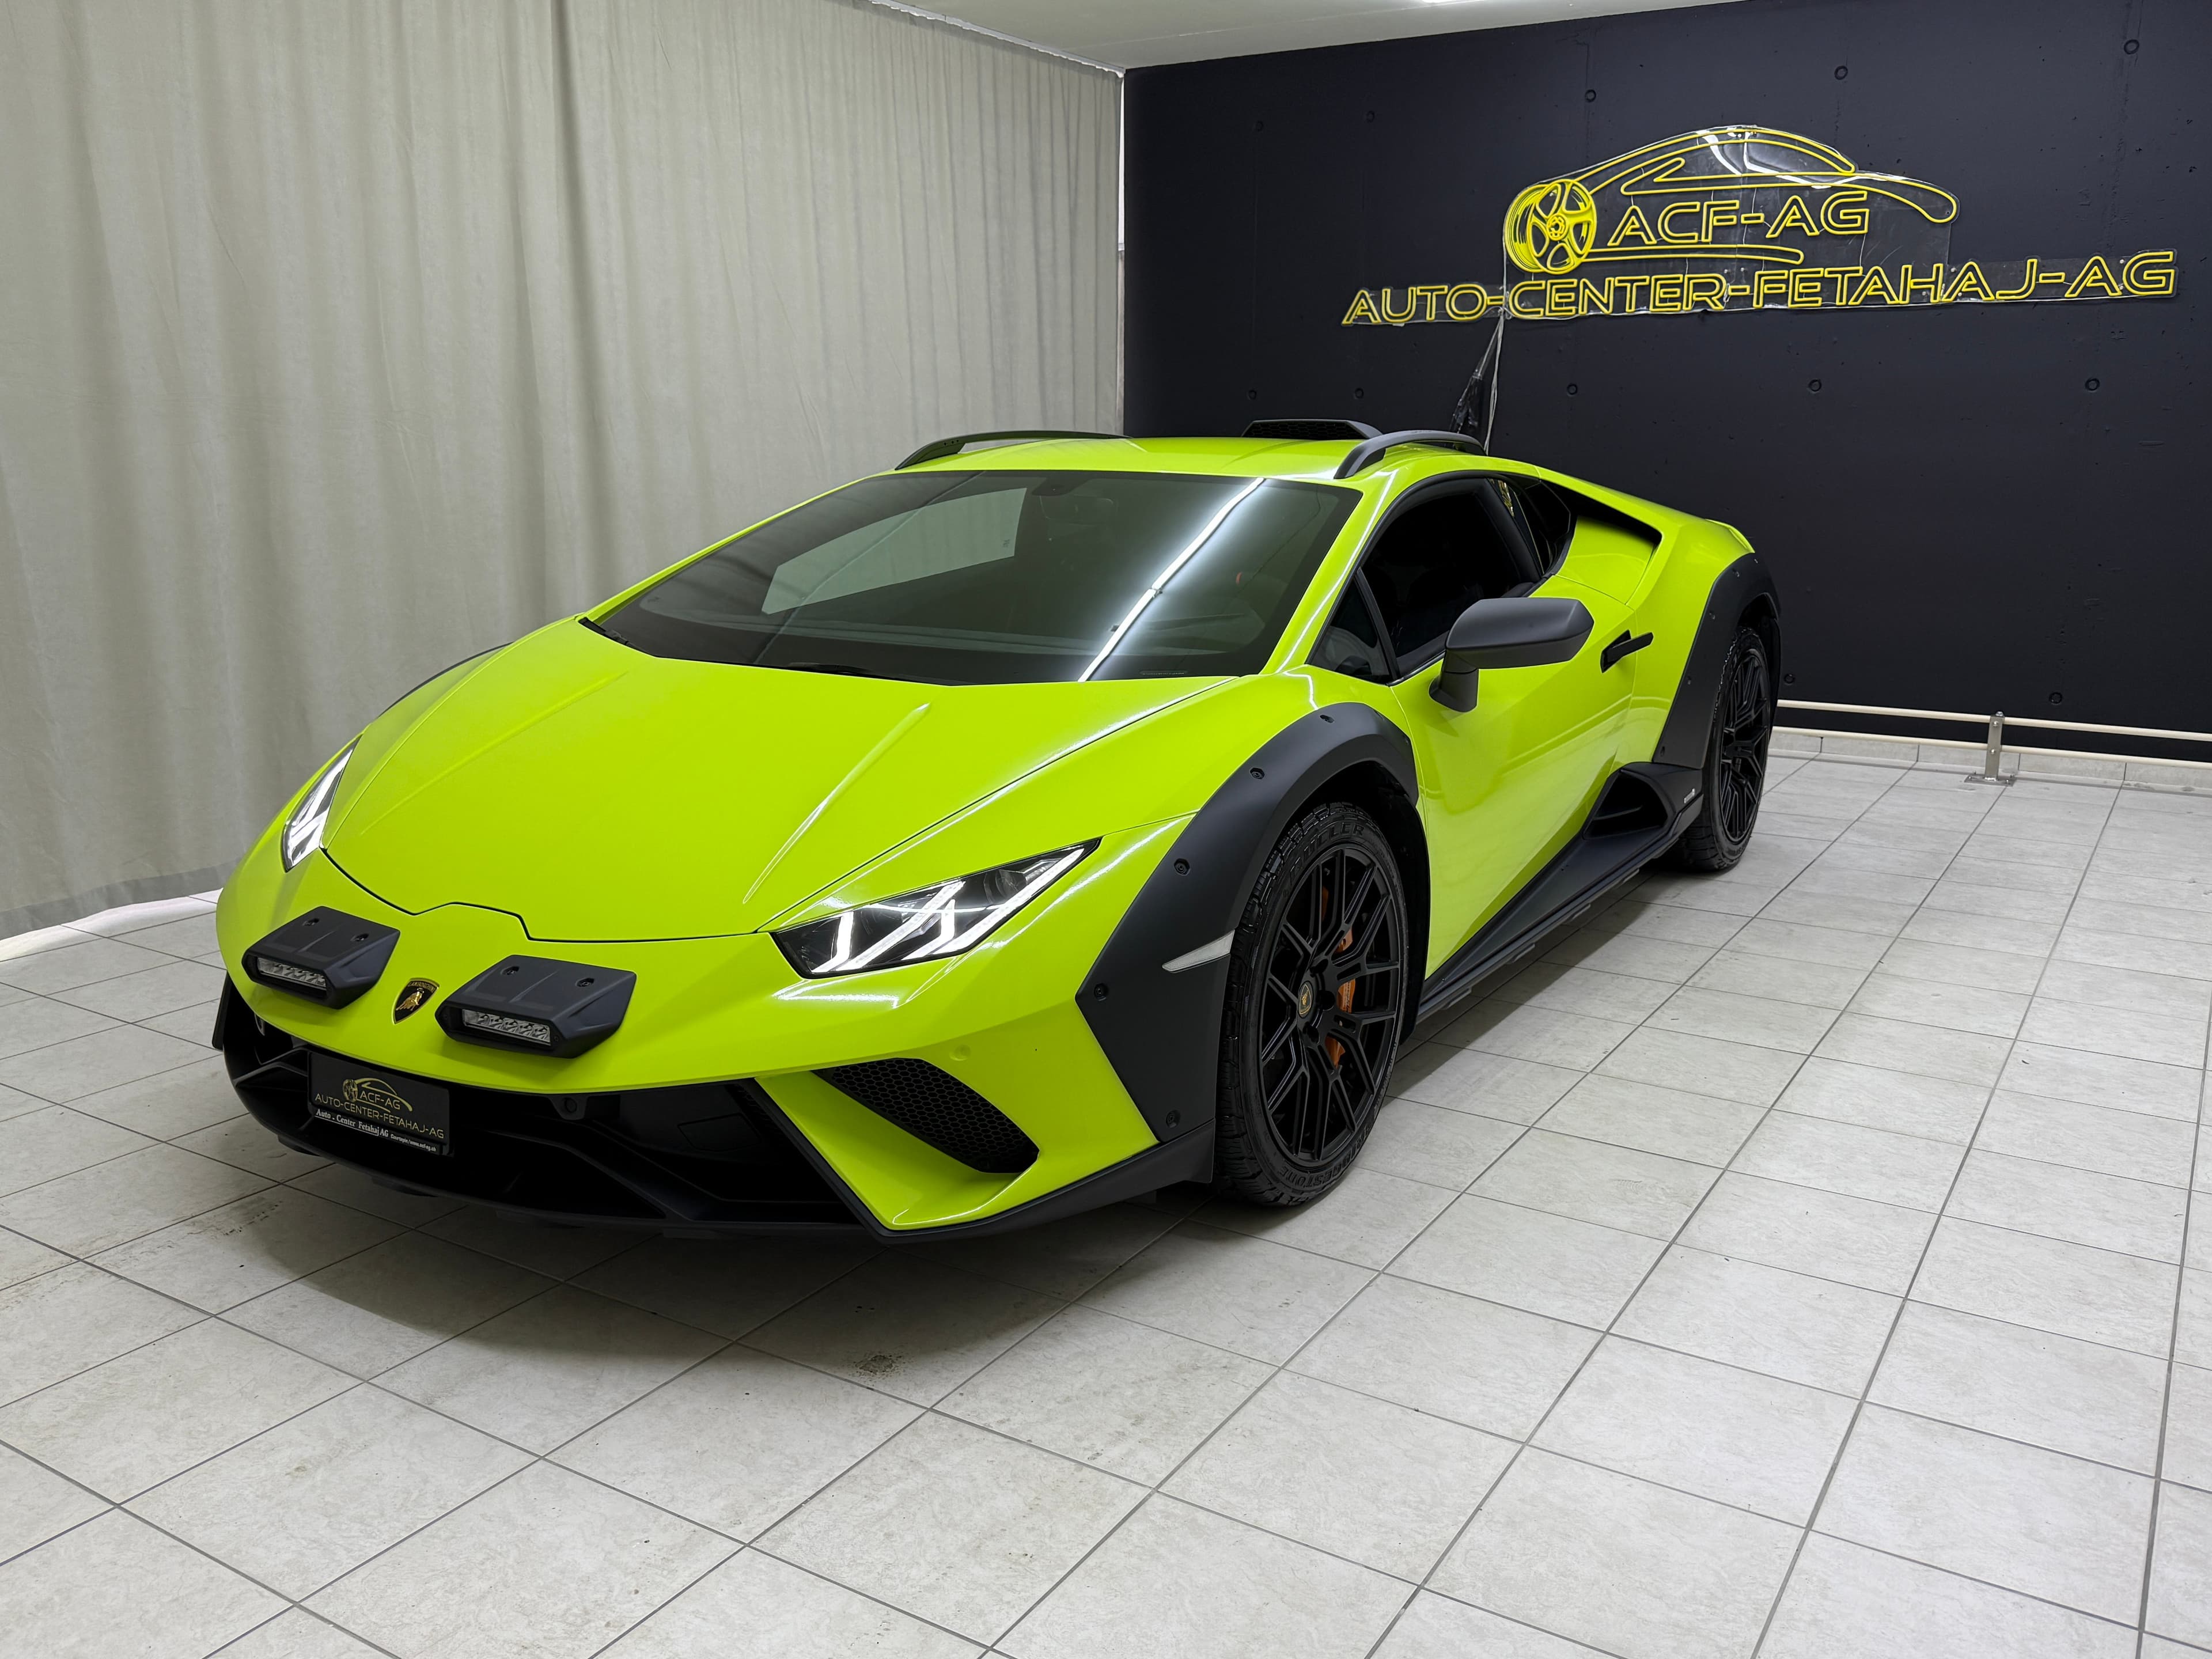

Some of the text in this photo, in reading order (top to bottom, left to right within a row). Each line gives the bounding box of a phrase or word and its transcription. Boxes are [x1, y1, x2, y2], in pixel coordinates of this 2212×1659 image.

[1608, 190, 1870, 247] ACF-AG
[1341, 250, 2176, 325] AUTO-CENTER-FETAHAJ-AG
[315, 1093, 444, 1139] AUTO-CENTER-FETAHAJ-AG
[359, 1090, 400, 1109] ACF-AG
[316, 1108, 331, 1119] Auto
[336, 1114, 356, 1127] Center
[358, 1121, 380, 1137] Fetahaj
[380, 1128, 389, 1138] AG
